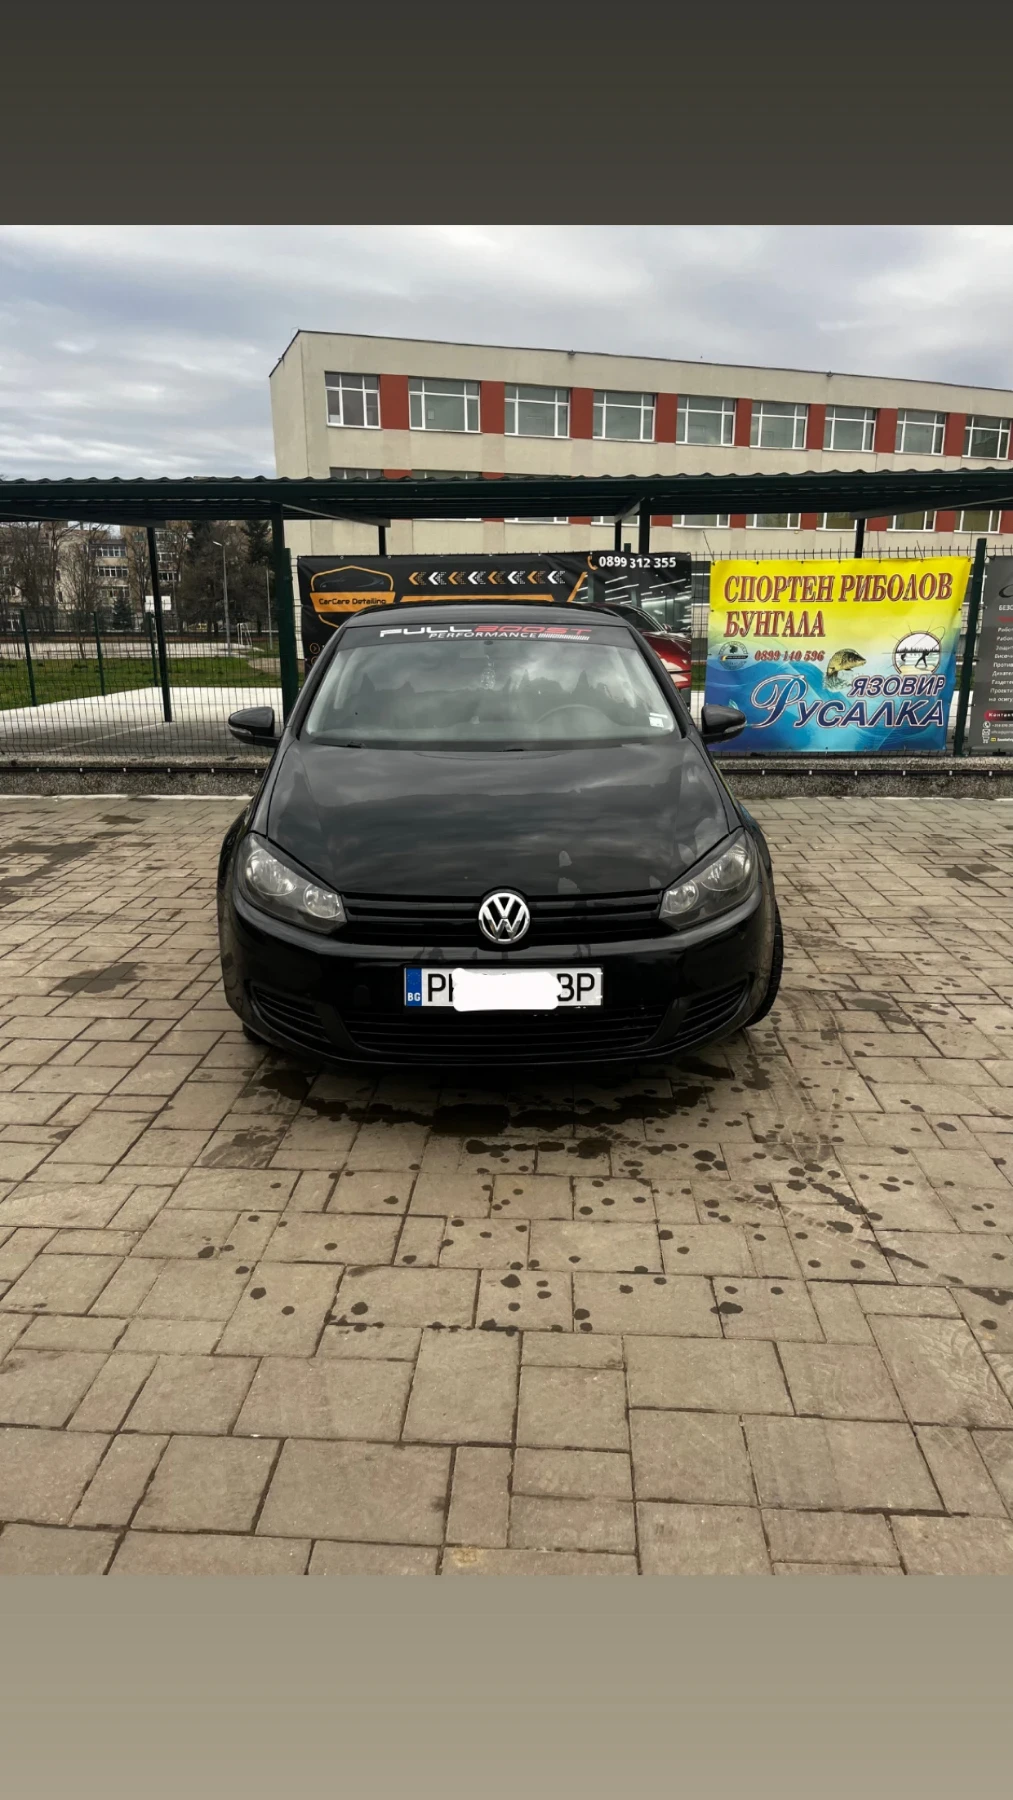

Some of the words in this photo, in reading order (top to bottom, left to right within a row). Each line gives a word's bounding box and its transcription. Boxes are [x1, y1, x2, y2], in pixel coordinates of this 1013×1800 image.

[599, 556, 627, 567] 0899
[629, 557, 650, 568] 312
[653, 556, 676, 568] 355
[724, 575, 835, 603] СПОРТЕН
[838, 572, 953, 602] РИБОЛОВ
[723, 610, 826, 637] БУНГАЛА
[429, 631, 538, 639] PERFORMANCE
[754, 650, 781, 661] 0899
[783, 650, 802, 661] 140
[804, 650, 826, 661] 596
[848, 674, 946, 698] ЯЗОВИР
[407, 992, 421, 1001] BG
